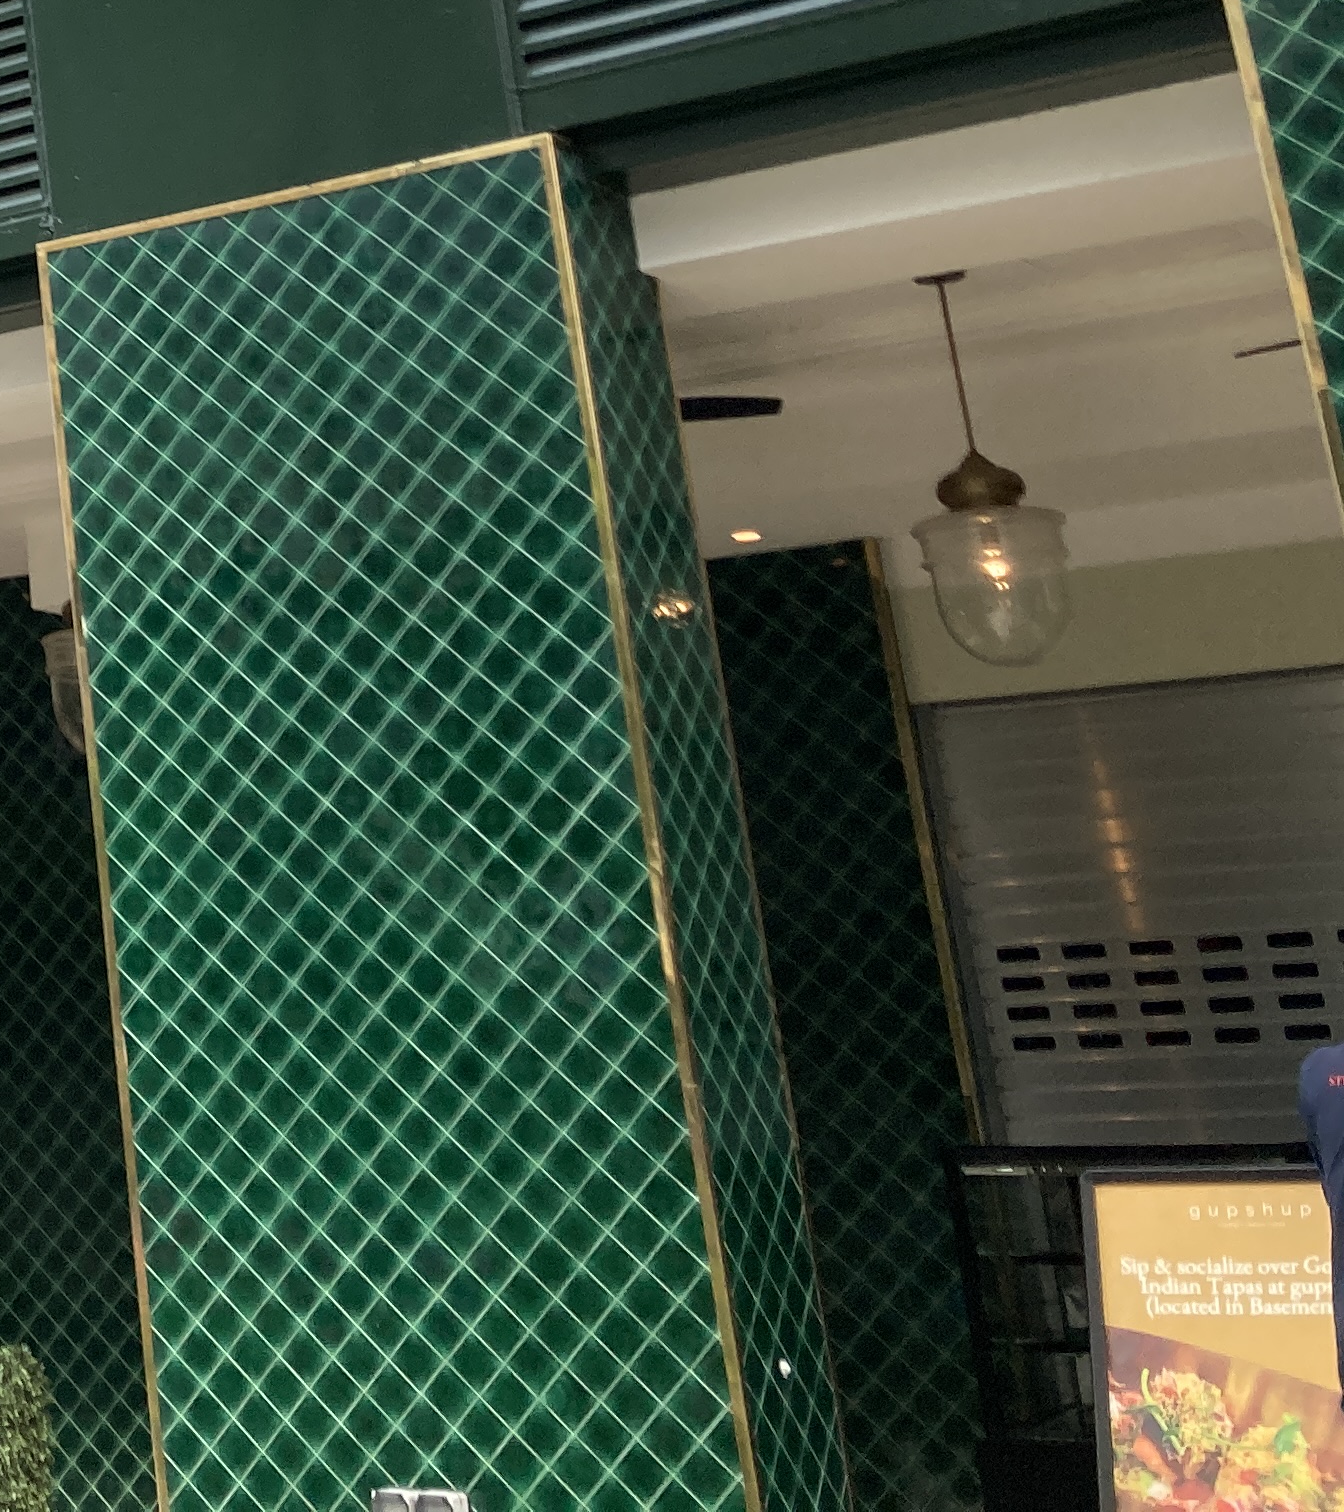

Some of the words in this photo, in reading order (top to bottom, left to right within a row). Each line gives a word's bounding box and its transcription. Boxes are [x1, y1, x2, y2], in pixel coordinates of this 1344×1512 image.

[1189, 1202, 1312, 1221] gupshup
[1120, 1255, 1150, 1282] Sip
[1154, 1256, 1171, 1275] &
[1177, 1254, 1254, 1276] socialize
[1257, 1261, 1299, 1276] over
[1140, 1275, 1202, 1295] Indian
[1206, 1275, 1263, 1301] Tapas
[1268, 1280, 1286, 1295] at
[1146, 1297, 1220, 1320] (located
[1226, 1296, 1244, 1315] in
[1250, 1296, 1333, 1316] Basemen
